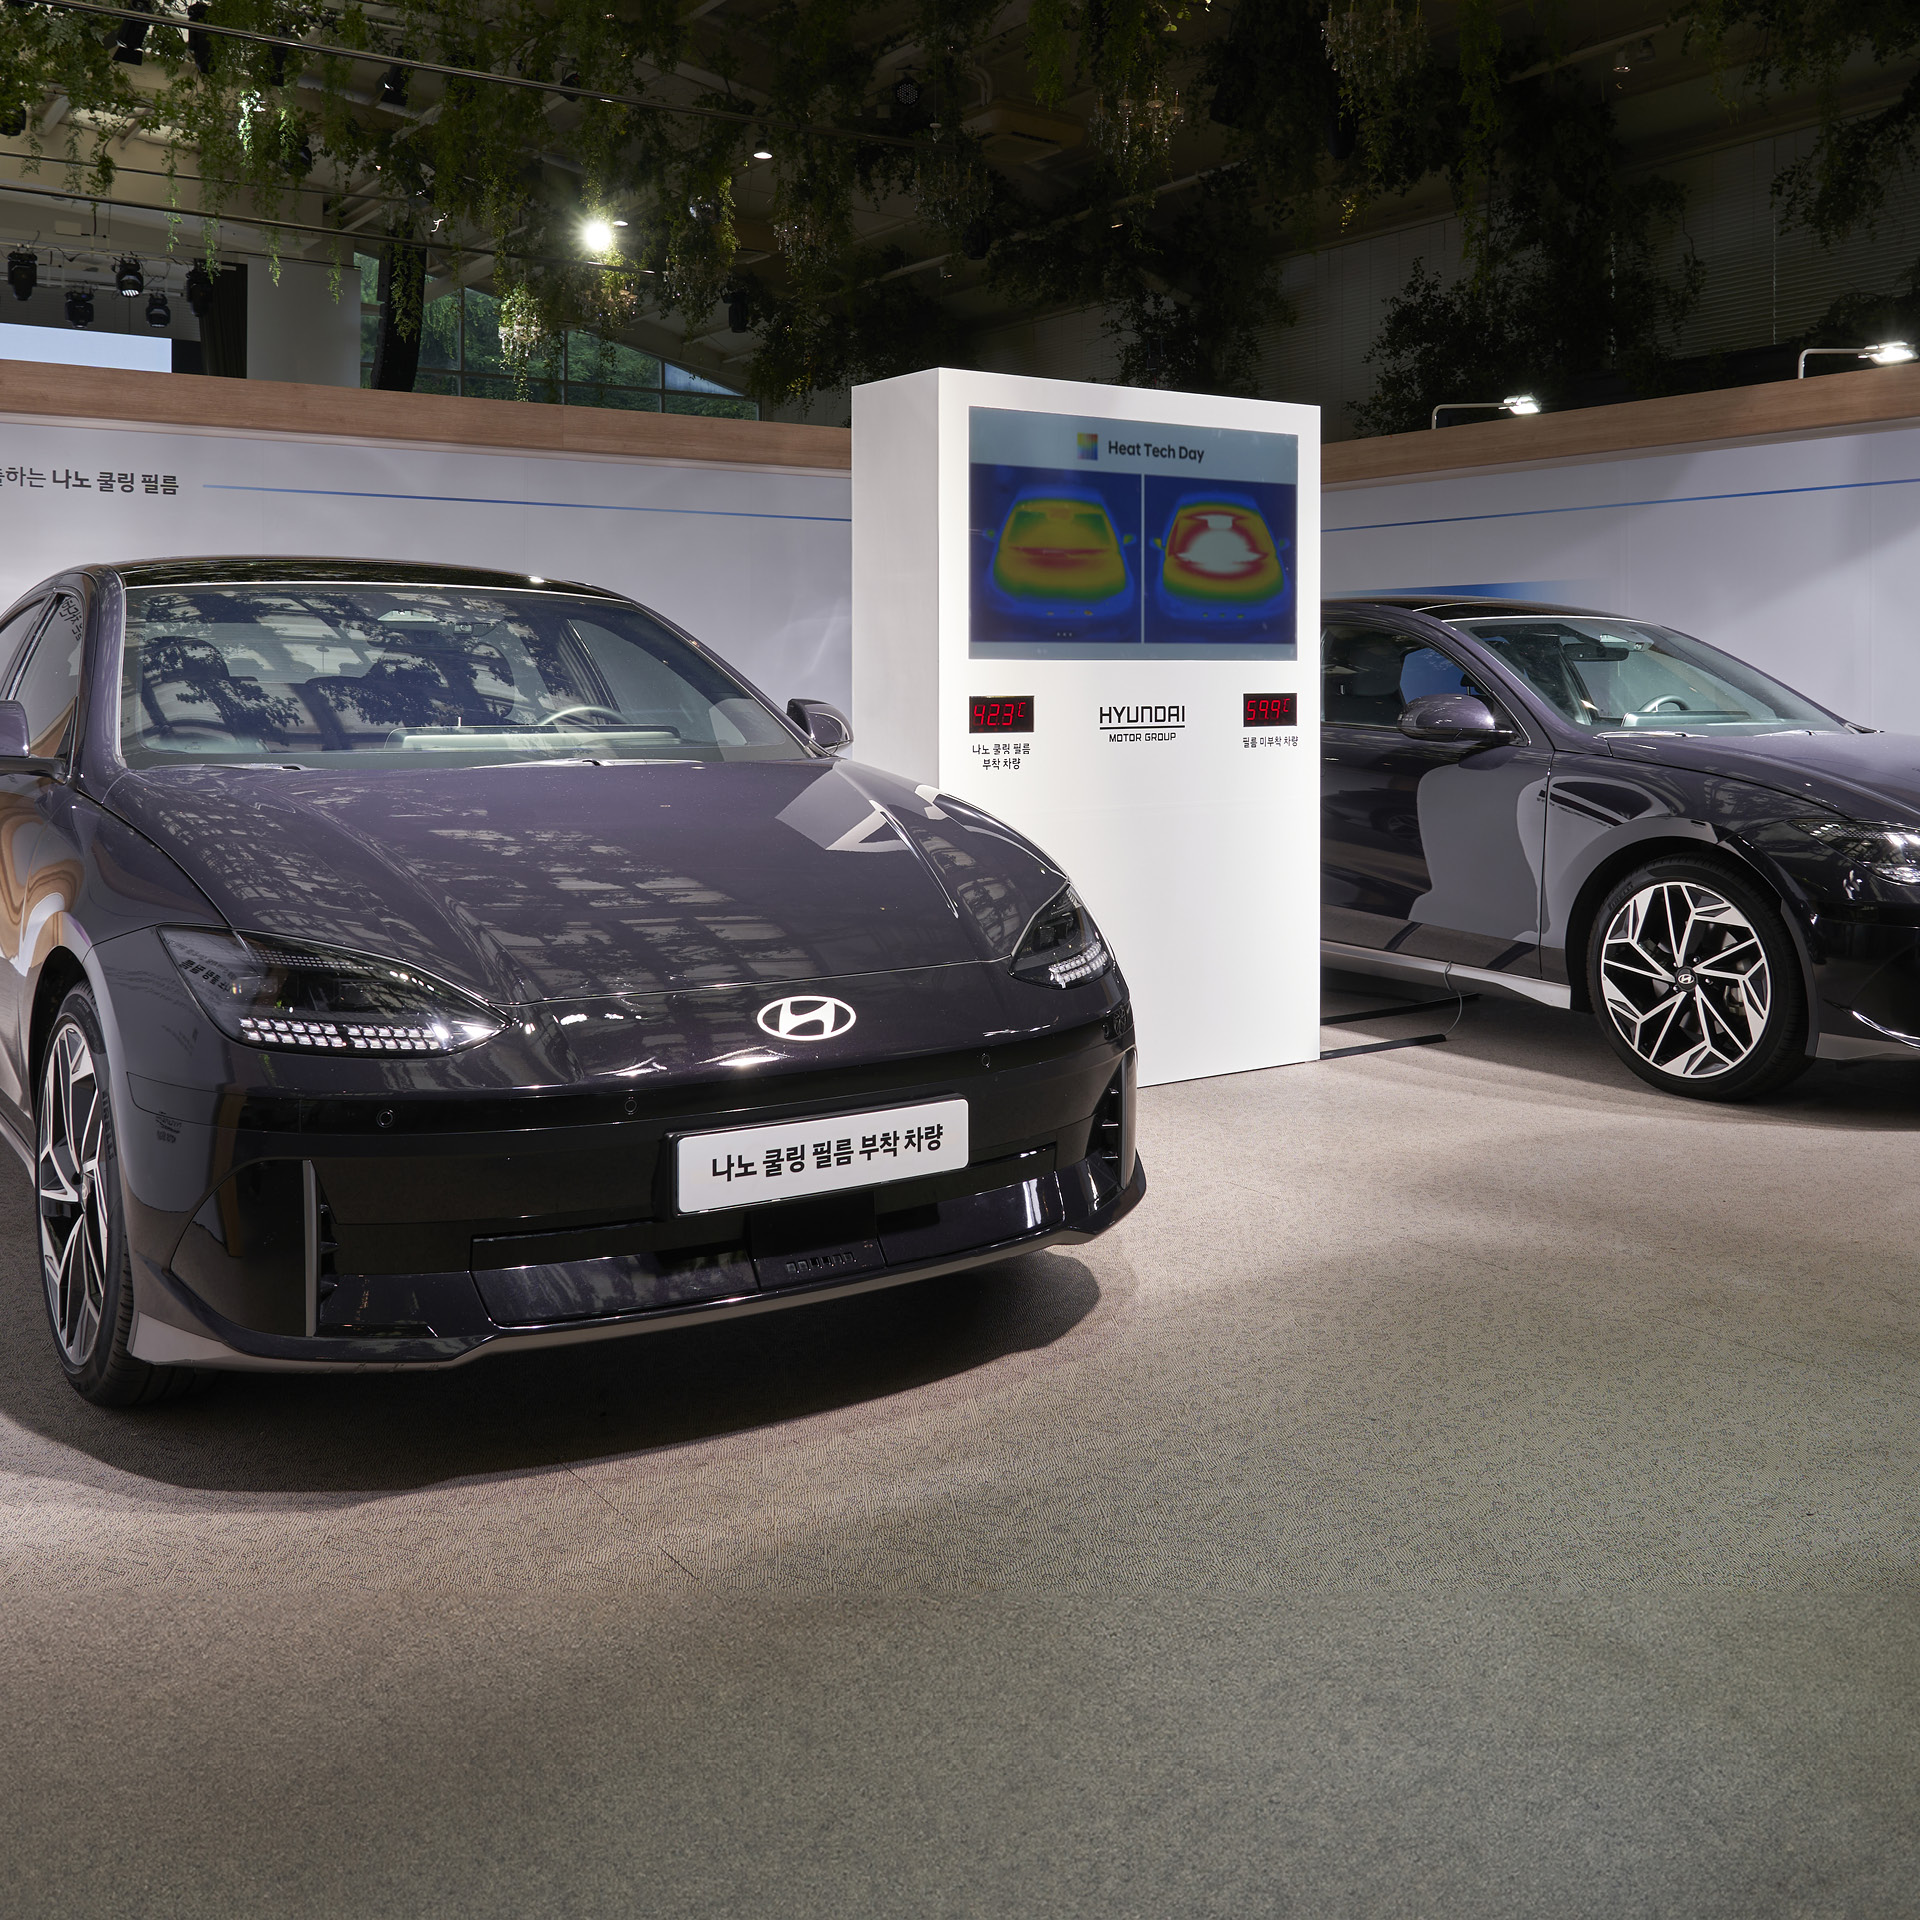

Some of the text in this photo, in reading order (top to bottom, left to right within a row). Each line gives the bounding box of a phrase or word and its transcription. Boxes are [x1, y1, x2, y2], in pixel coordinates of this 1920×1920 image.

[1108, 441, 1204, 463] Heat Tech Day
[52, 469, 92, 489] 나노
[97, 472, 135, 493] 쿨링
[141, 473, 179, 495] 필름
[1100, 706, 1185, 723] HYUNDAI
[1109, 732, 1176, 742] MOTOR GROUP
[1243, 736, 1298, 748] 필름 미부착 차량
[972, 743, 1031, 755] 나노 쿨링 필름
[983, 758, 1021, 770] 부착 차량
[712, 1123, 943, 1182] 나노 쿨링 필름 부착 차량
